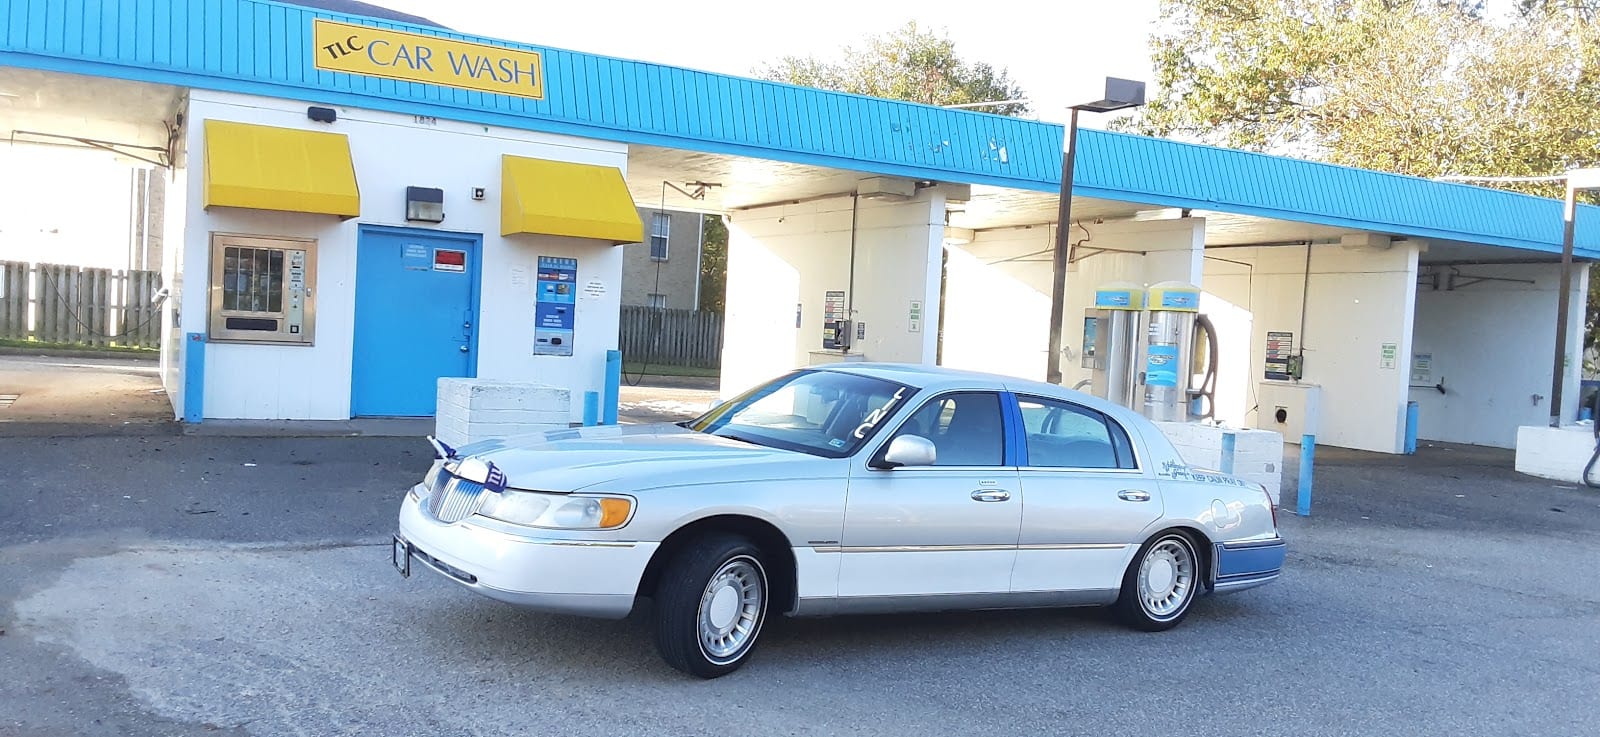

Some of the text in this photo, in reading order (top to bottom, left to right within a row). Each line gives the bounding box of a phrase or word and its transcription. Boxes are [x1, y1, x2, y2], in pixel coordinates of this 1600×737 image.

[322, 35, 536, 87] TLC CAR WASH
